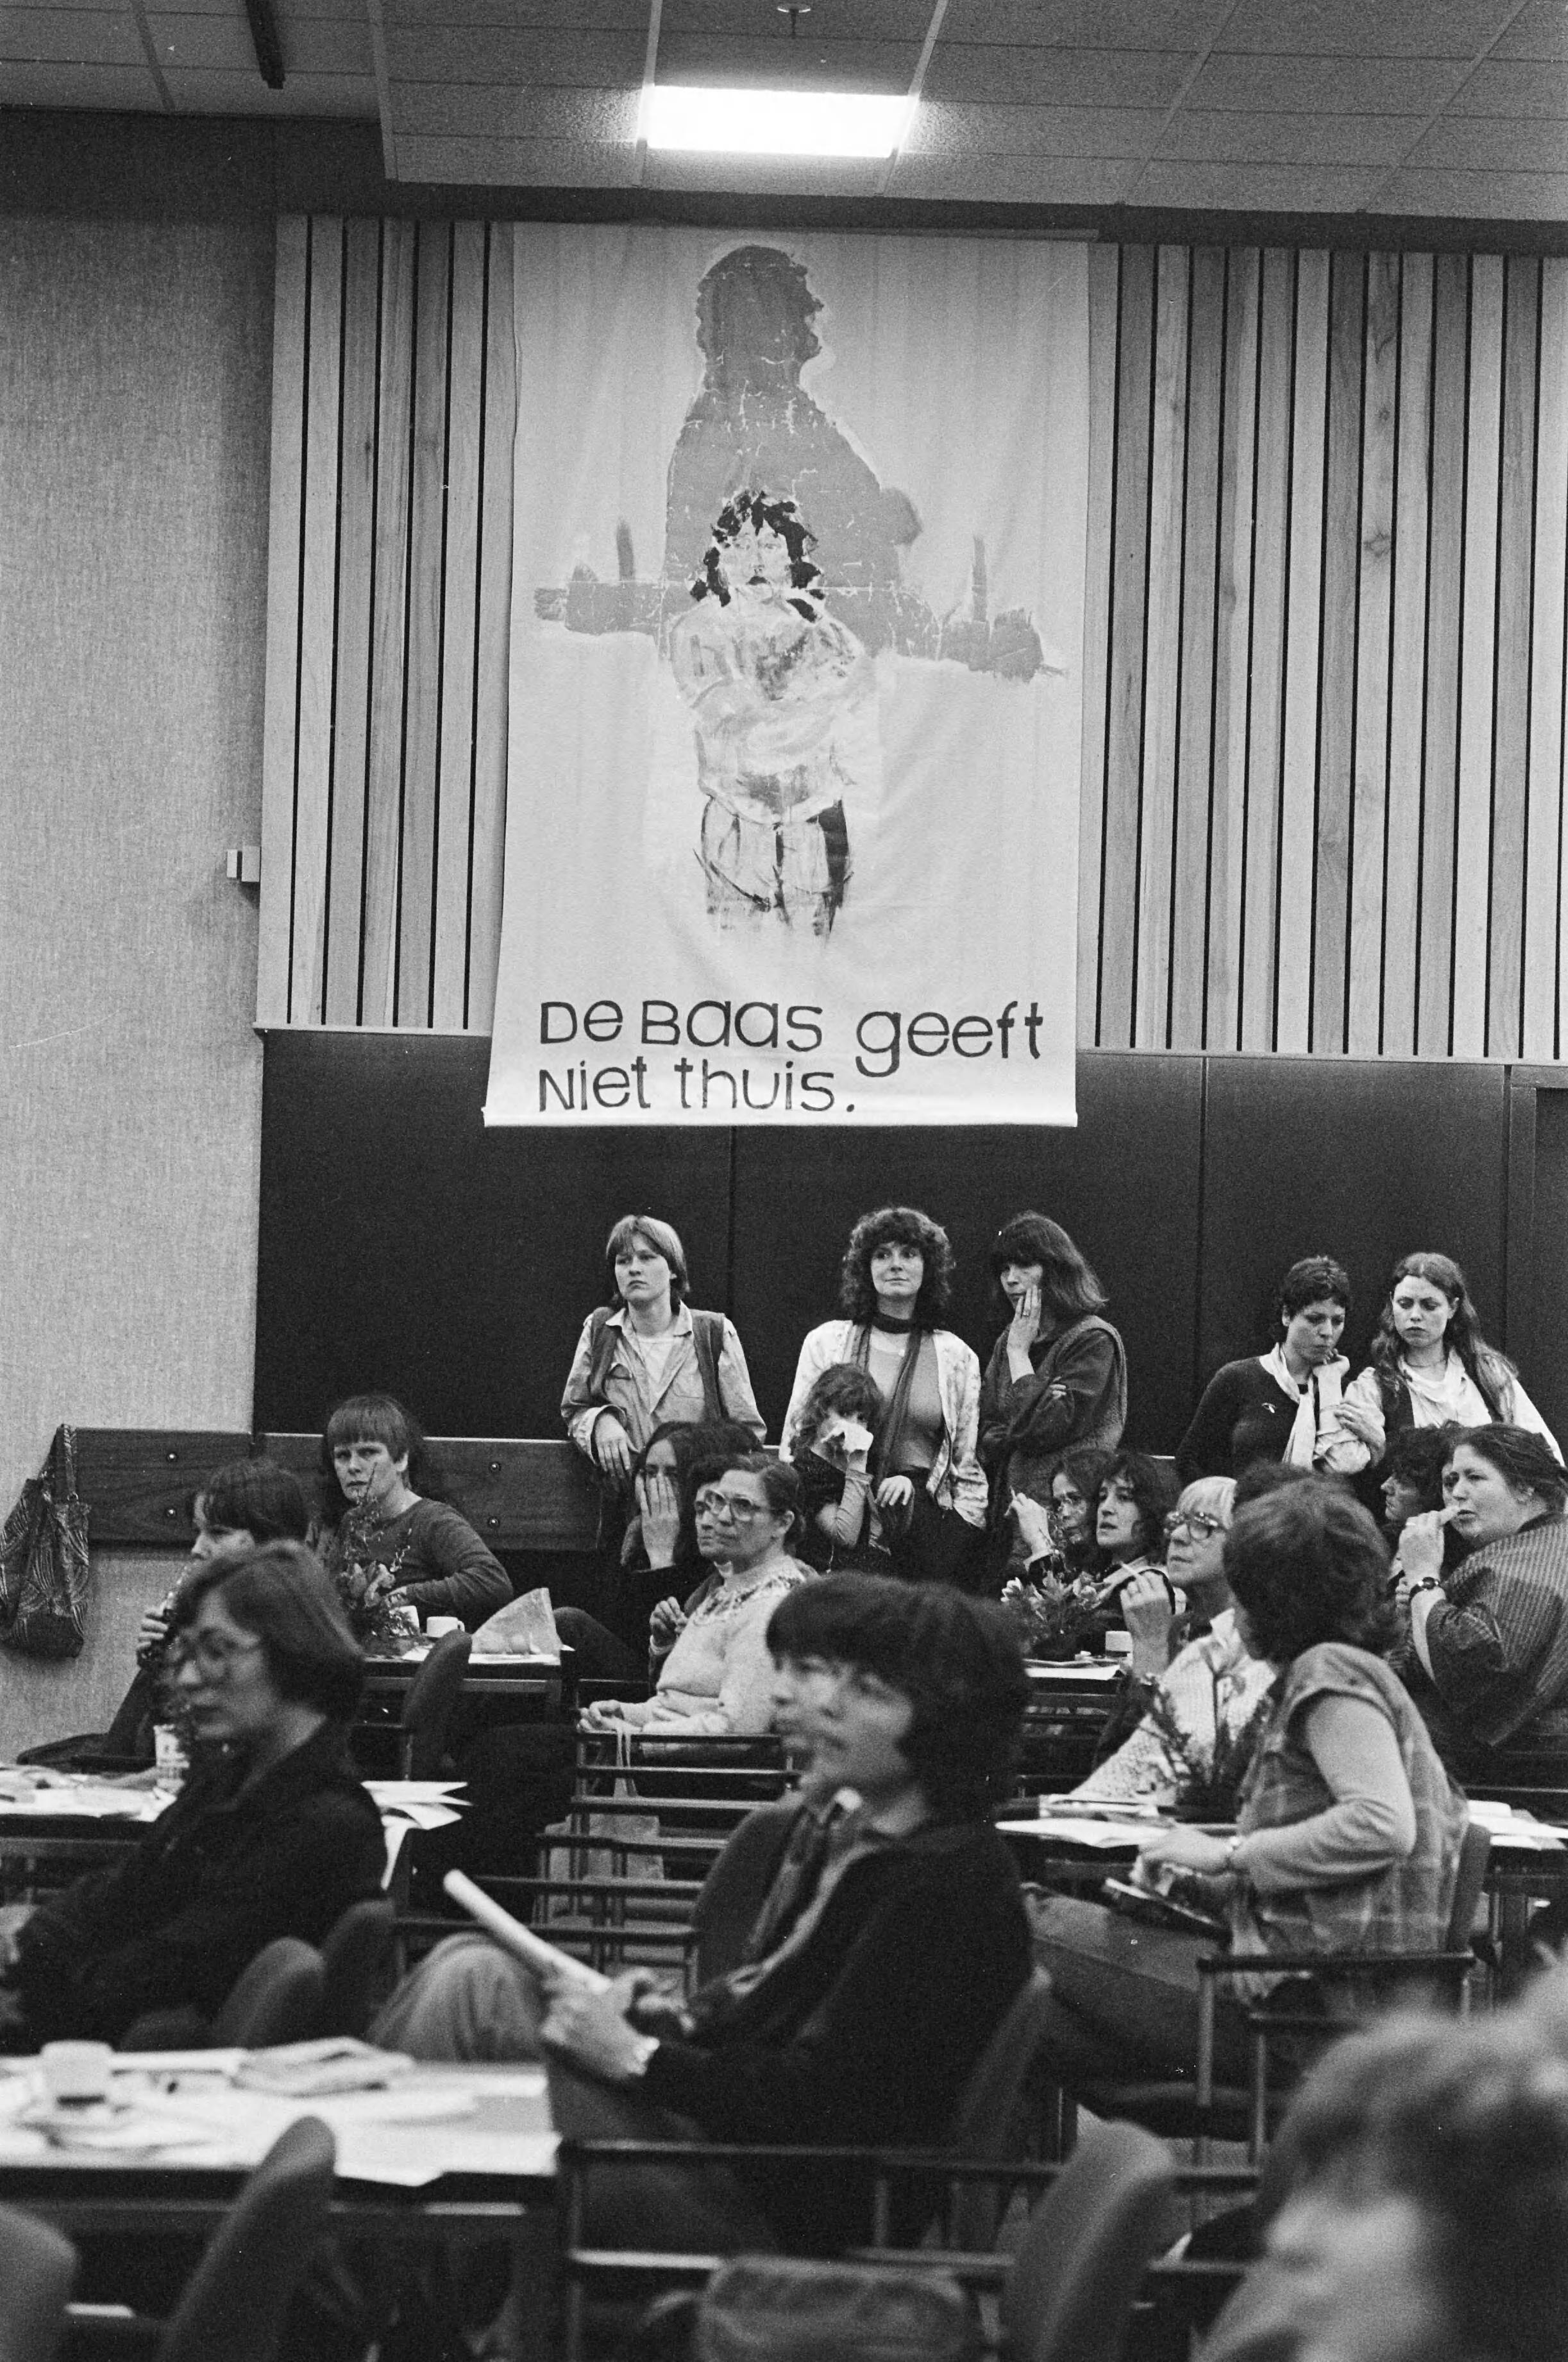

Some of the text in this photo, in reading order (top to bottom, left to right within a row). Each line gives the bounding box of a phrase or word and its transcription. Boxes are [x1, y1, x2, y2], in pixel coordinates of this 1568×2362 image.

[539, 999, 1044, 1078] De Baas geeft
[539, 1055, 856, 1113] Niet thuis.
